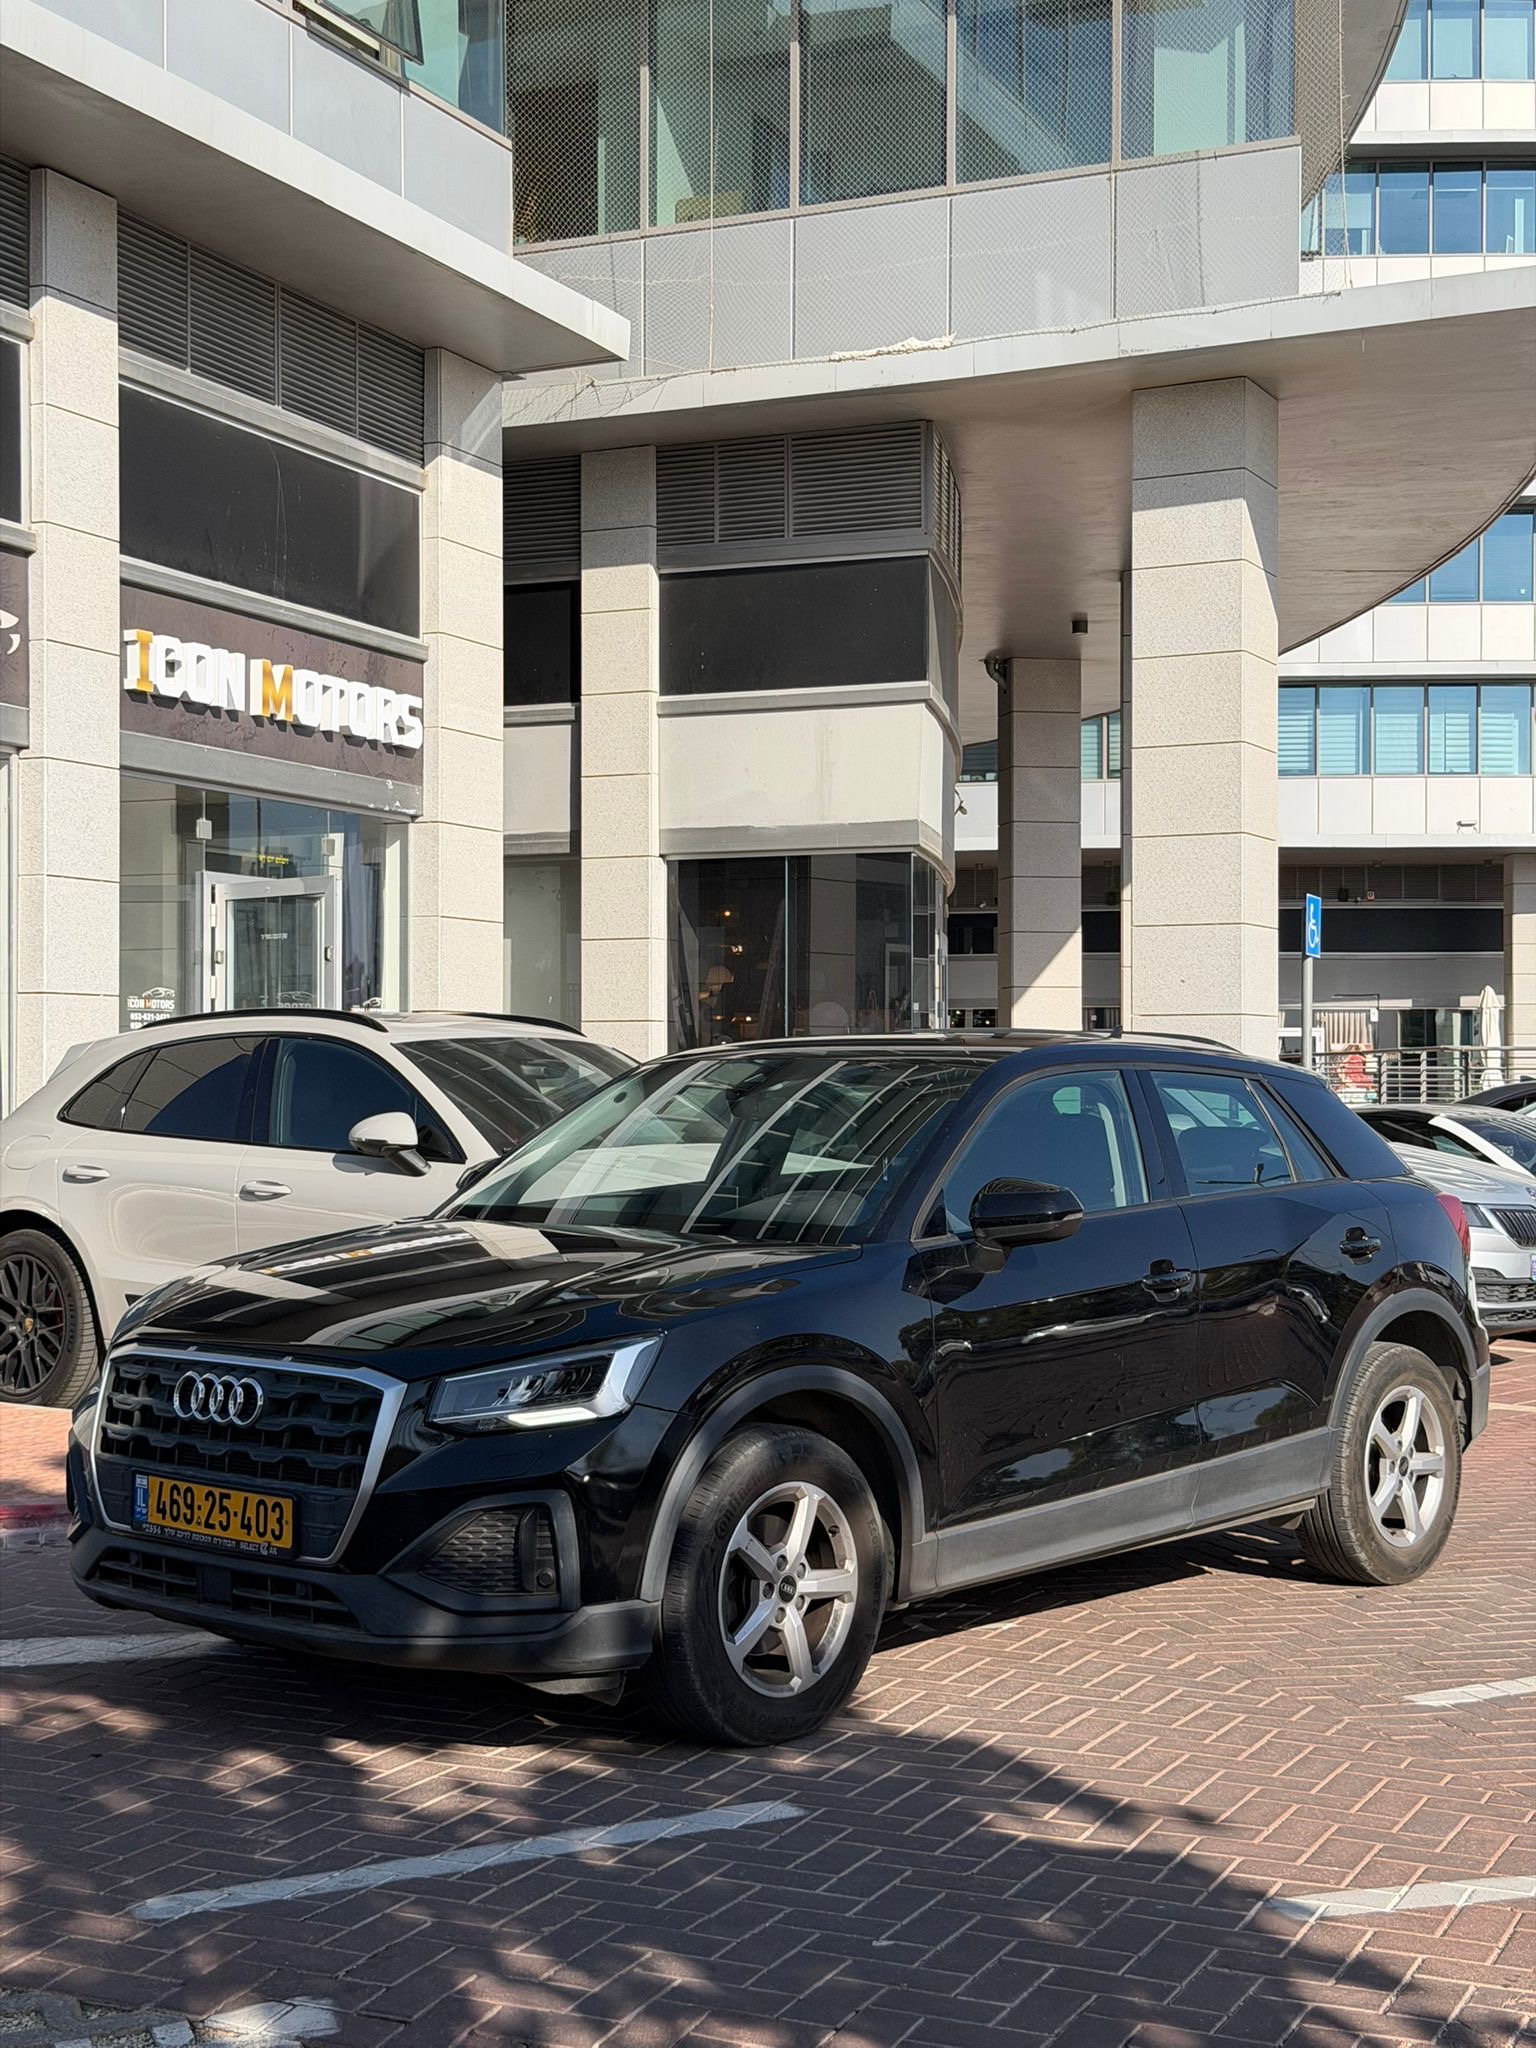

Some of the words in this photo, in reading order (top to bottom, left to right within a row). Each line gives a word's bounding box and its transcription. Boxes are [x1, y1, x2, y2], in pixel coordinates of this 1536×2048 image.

[124, 629, 246, 712] ICON
[250, 658, 424, 749] MOTORS
[137, 1487, 146, 1507] IL
